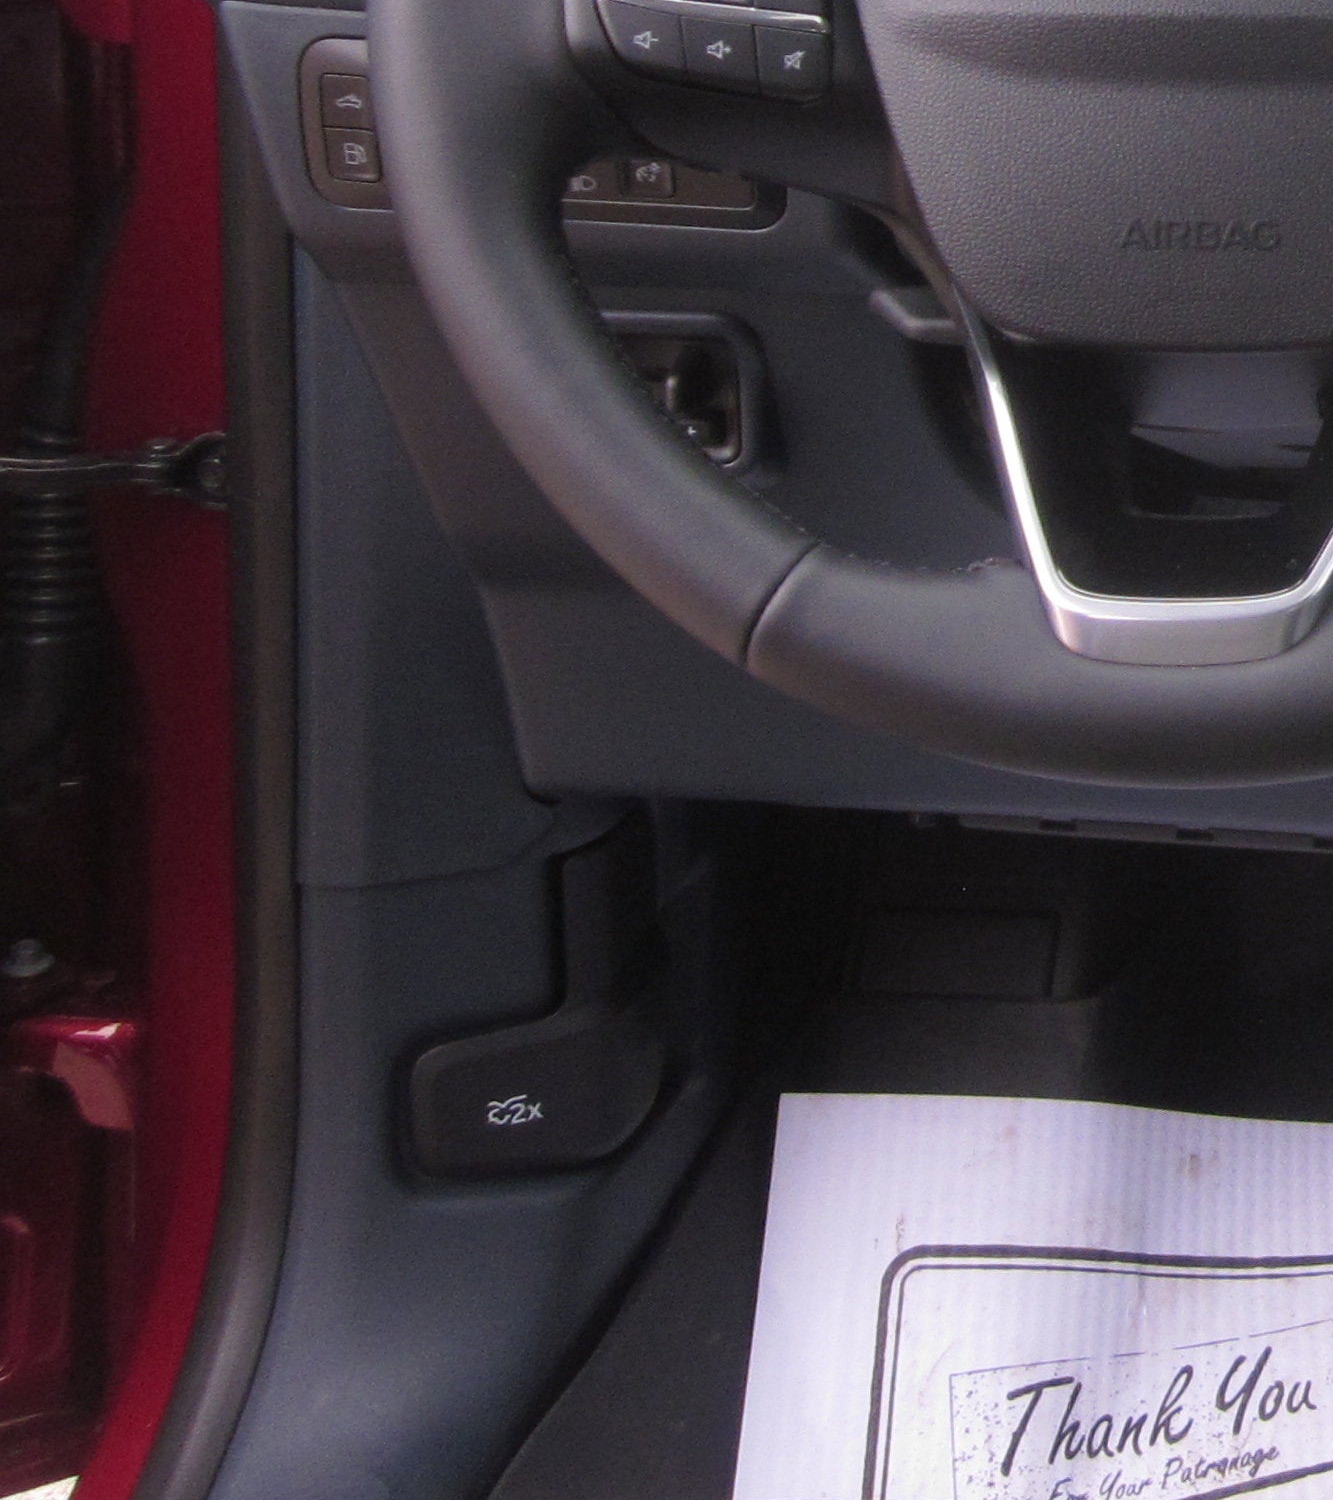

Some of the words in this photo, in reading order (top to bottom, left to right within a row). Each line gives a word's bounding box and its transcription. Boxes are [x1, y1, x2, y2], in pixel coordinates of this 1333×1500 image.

[1120, 218, 1284, 252] AIRBAG
[1001, 1364, 1194, 1476] Thank
[1216, 1347, 1318, 1436] You
